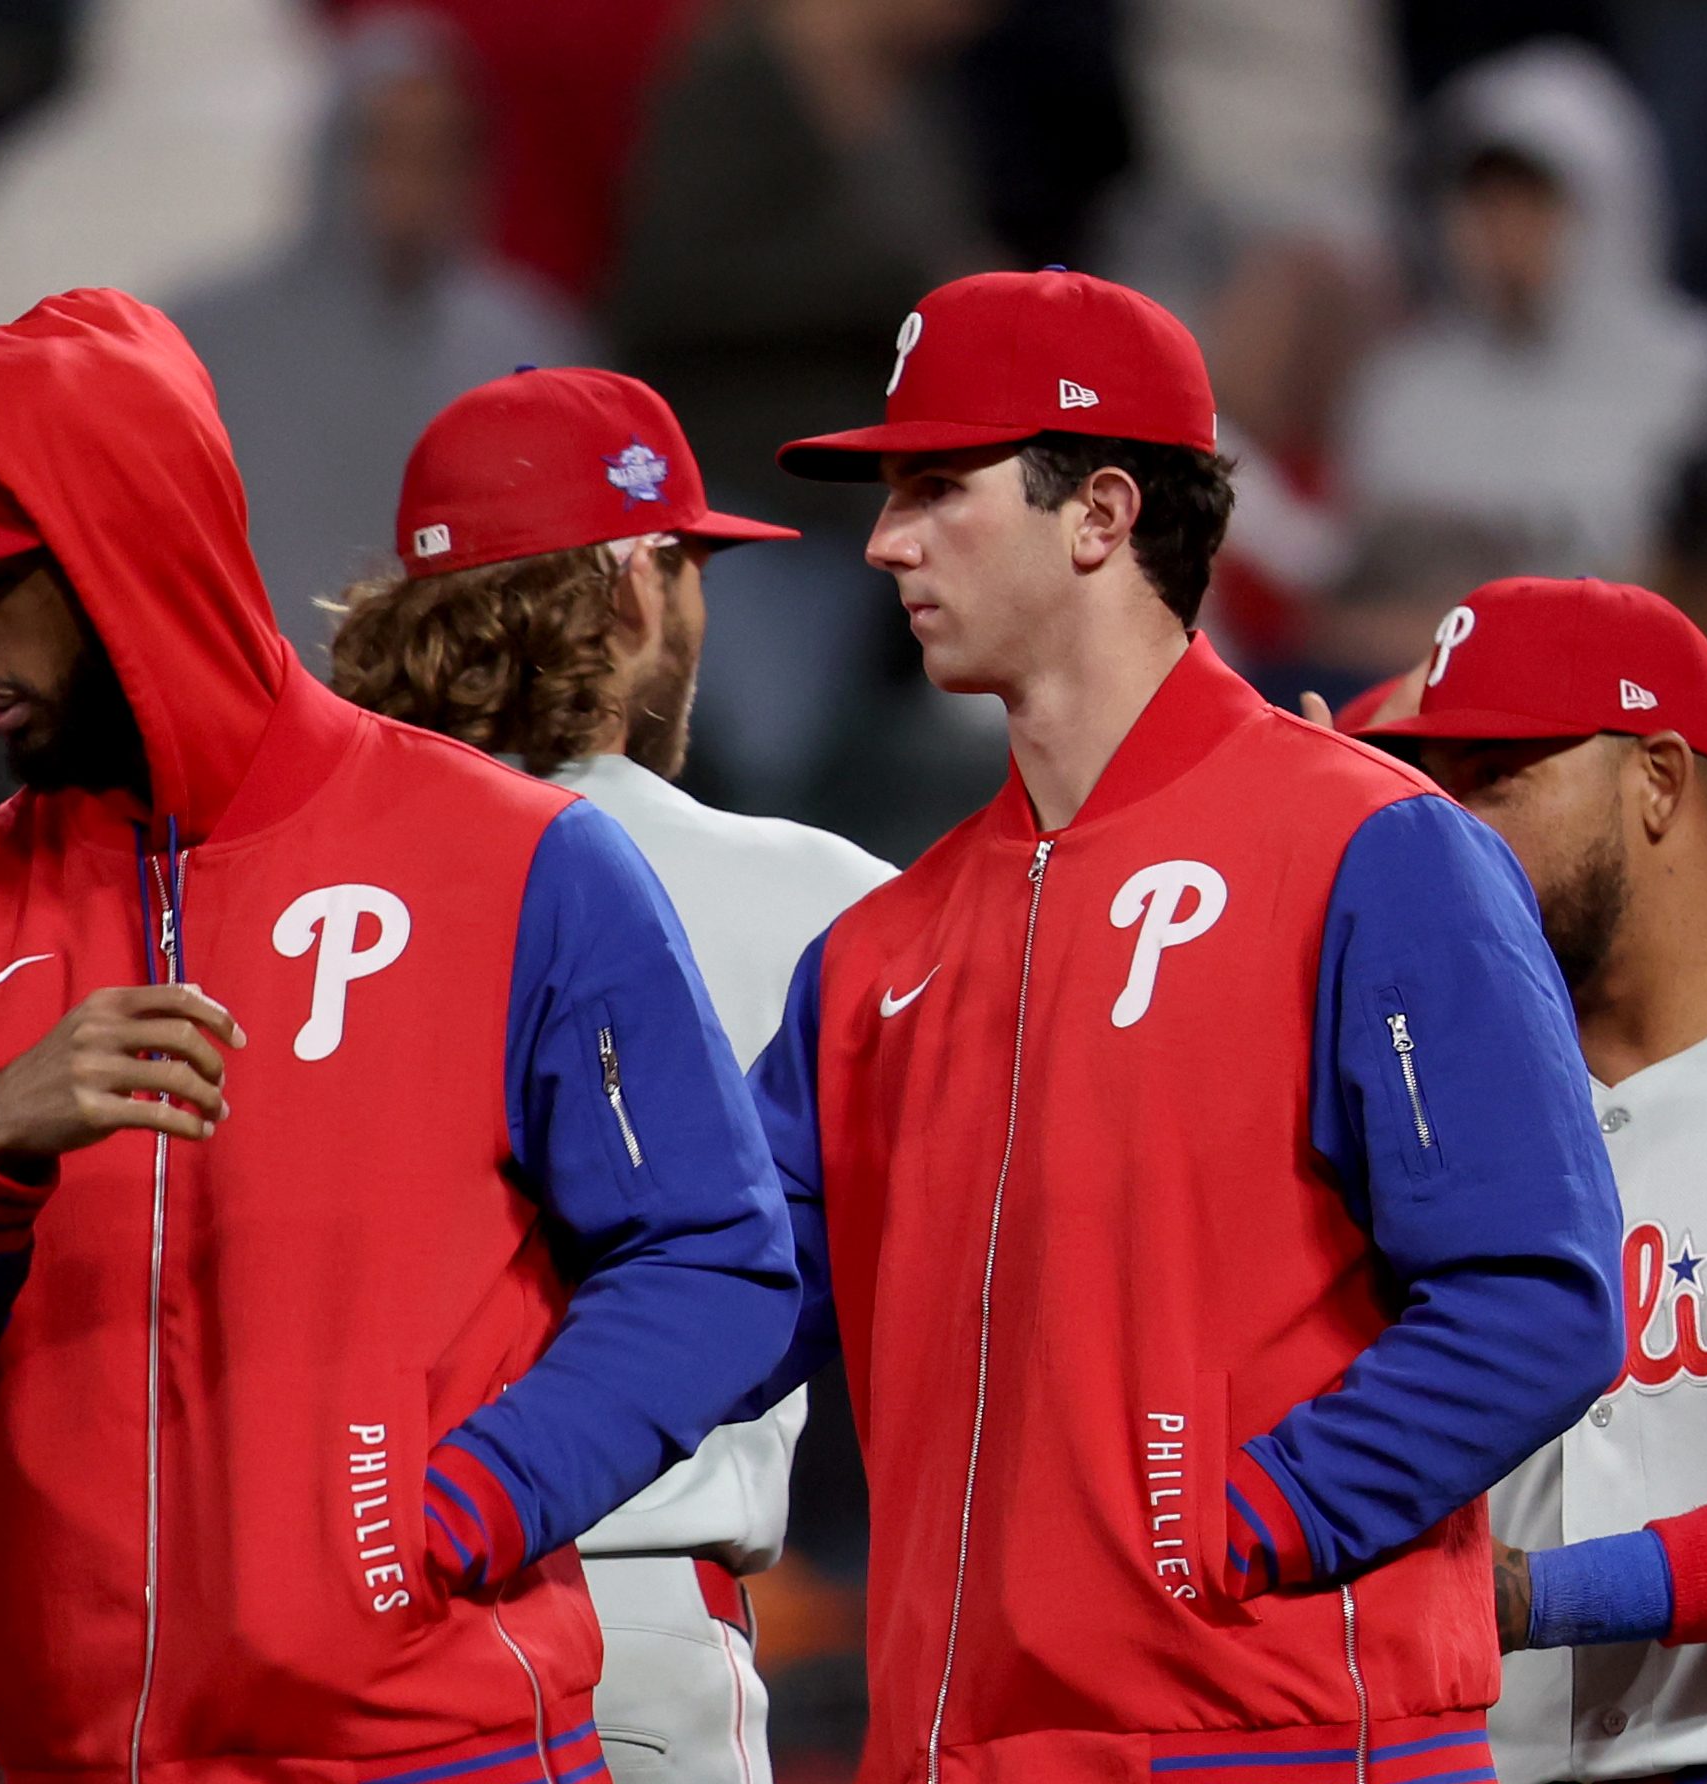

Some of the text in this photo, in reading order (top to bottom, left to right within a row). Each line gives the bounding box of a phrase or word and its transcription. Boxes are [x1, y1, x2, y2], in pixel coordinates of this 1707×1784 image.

[1428, 606, 1476, 687] P
[272, 883, 412, 1062] P
[1109, 859, 1229, 1029] P
[349, 1423, 410, 1612] PHILLIES
